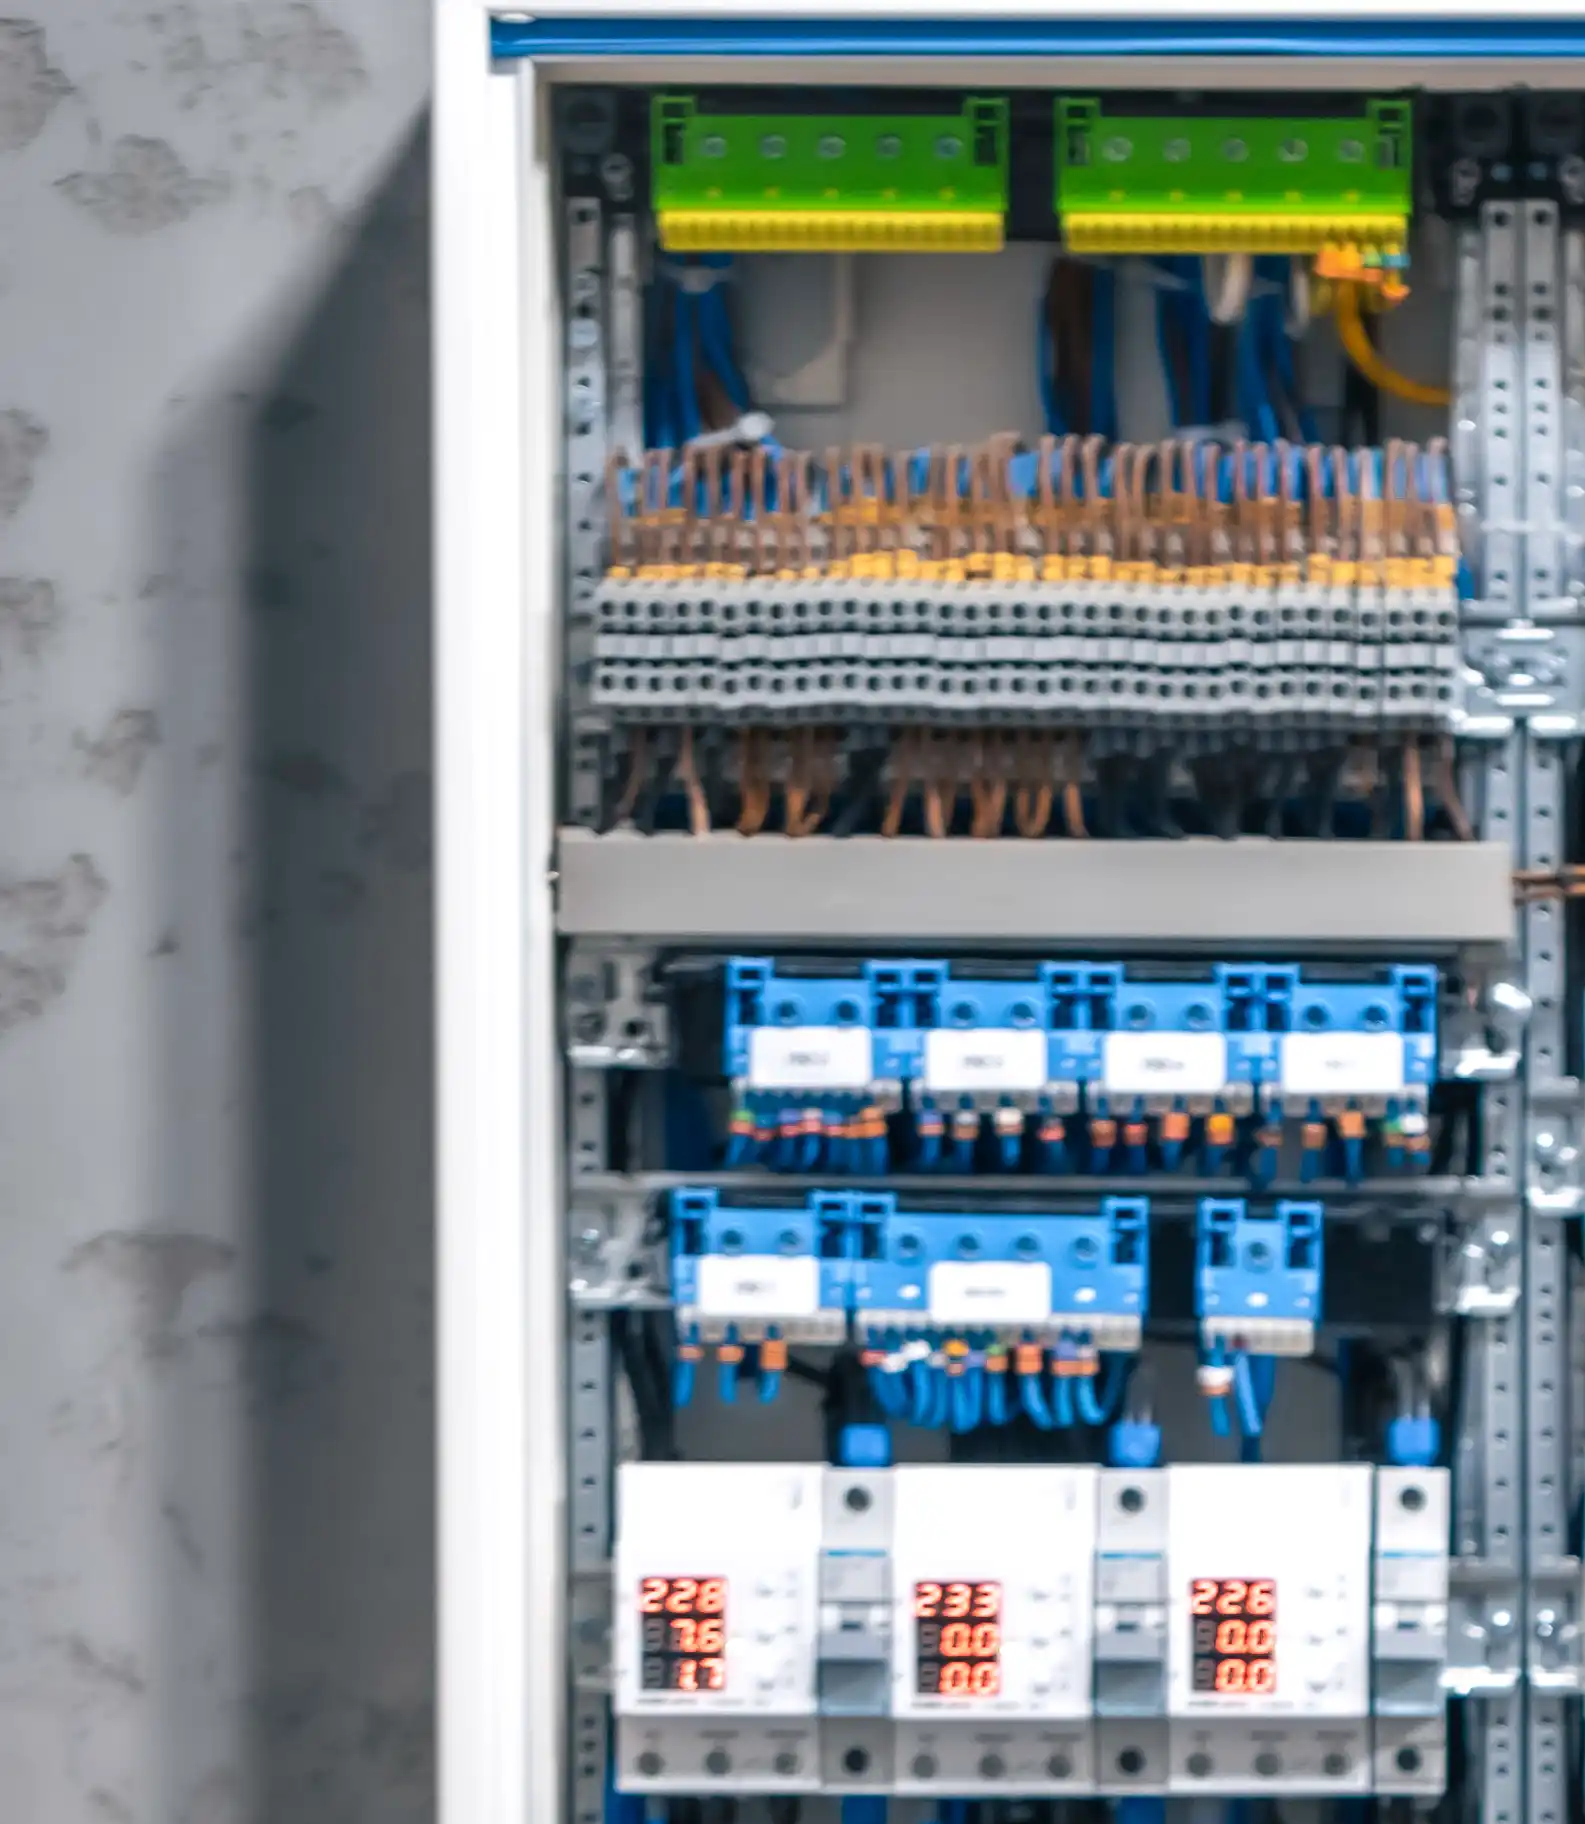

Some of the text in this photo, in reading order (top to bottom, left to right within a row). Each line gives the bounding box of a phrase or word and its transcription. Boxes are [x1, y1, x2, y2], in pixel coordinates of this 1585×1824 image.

[640, 1578, 726, 1613] 228
[915, 1583, 1000, 1618] 233
[1191, 1579, 1275, 1615] 226
